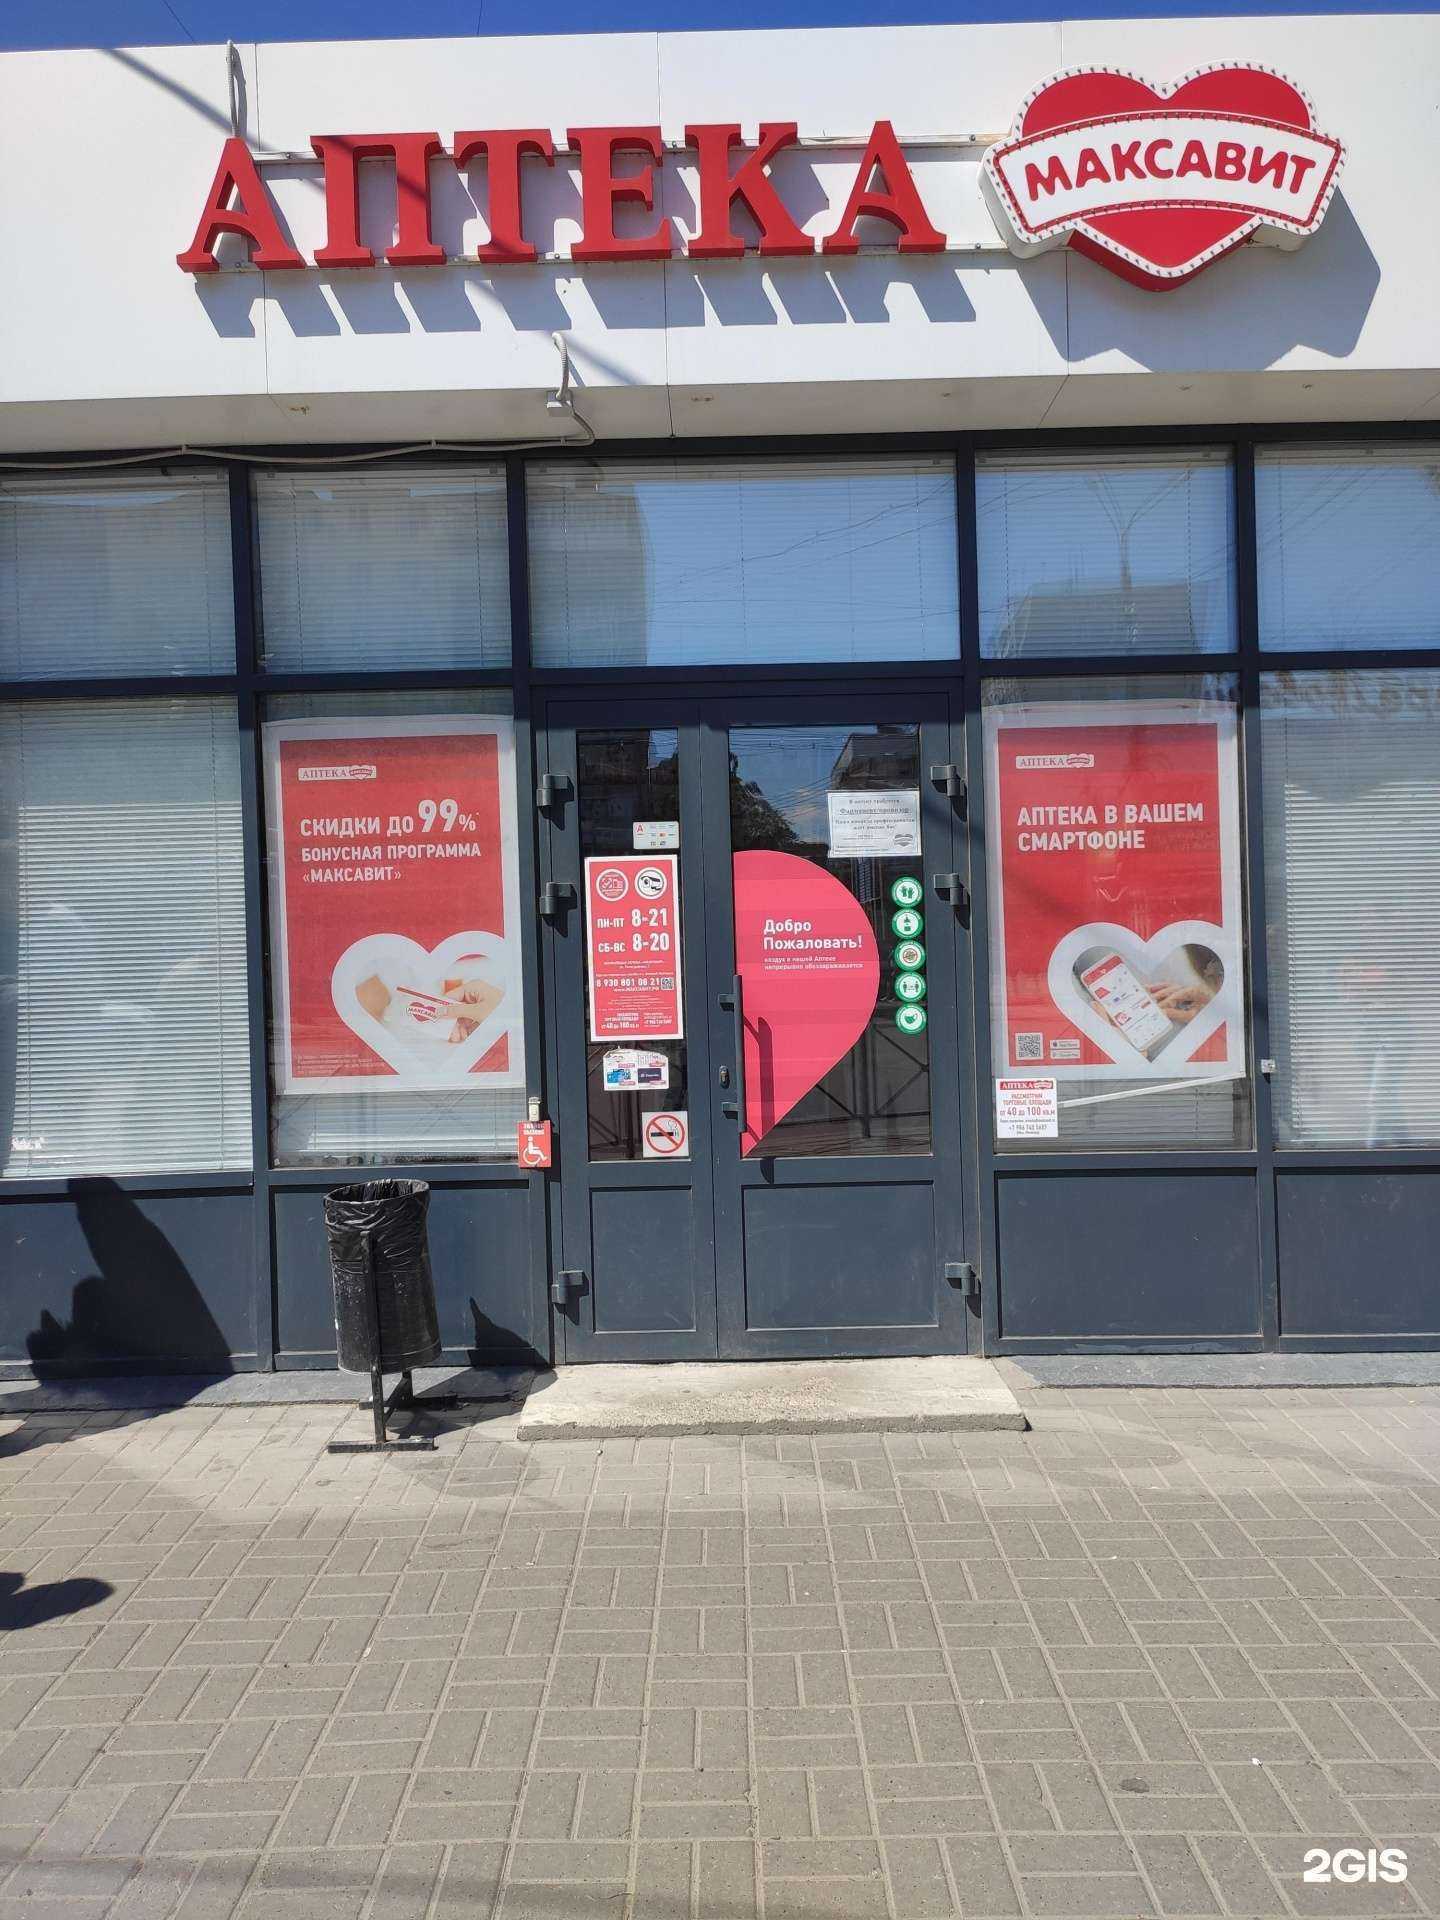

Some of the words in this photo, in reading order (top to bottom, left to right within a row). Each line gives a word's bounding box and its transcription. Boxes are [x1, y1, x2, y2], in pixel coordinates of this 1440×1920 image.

[1024, 138, 1316, 201] МАКСАВИТ
[176, 120, 948, 273] АПТЕКА
[1019, 757, 1065, 767] АПТЕКА
[302, 767, 347, 779] АПТЕКА
[1017, 805, 1099, 826] АПТЕКА
[1104, 805, 1118, 824] В
[1125, 802, 1204, 824] ВАШЕМ
[300, 816, 381, 838] СКИДКИ
[387, 815, 414, 837] ДО
[1017, 830, 1145, 851] СМАРТФОНЕ
[302, 846, 381, 862] БОНУСНАЯ
[387, 843, 482, 859] ПРОГРАММА
[303, 867, 402, 883] «МАКСАВИТ»
[597, 917, 625, 928] ПН-ПТ
[631, 907, 668, 927] 8-21
[763, 918, 812, 935] Добро
[598, 942, 626, 953] СБ-ВС
[632, 932, 670, 952] 8-20
[763, 935, 863, 951] Пожаловать!
[1002, 1081, 1034, 1089] АПТЕКА
[1027, 1106, 1041, 1116] 100
